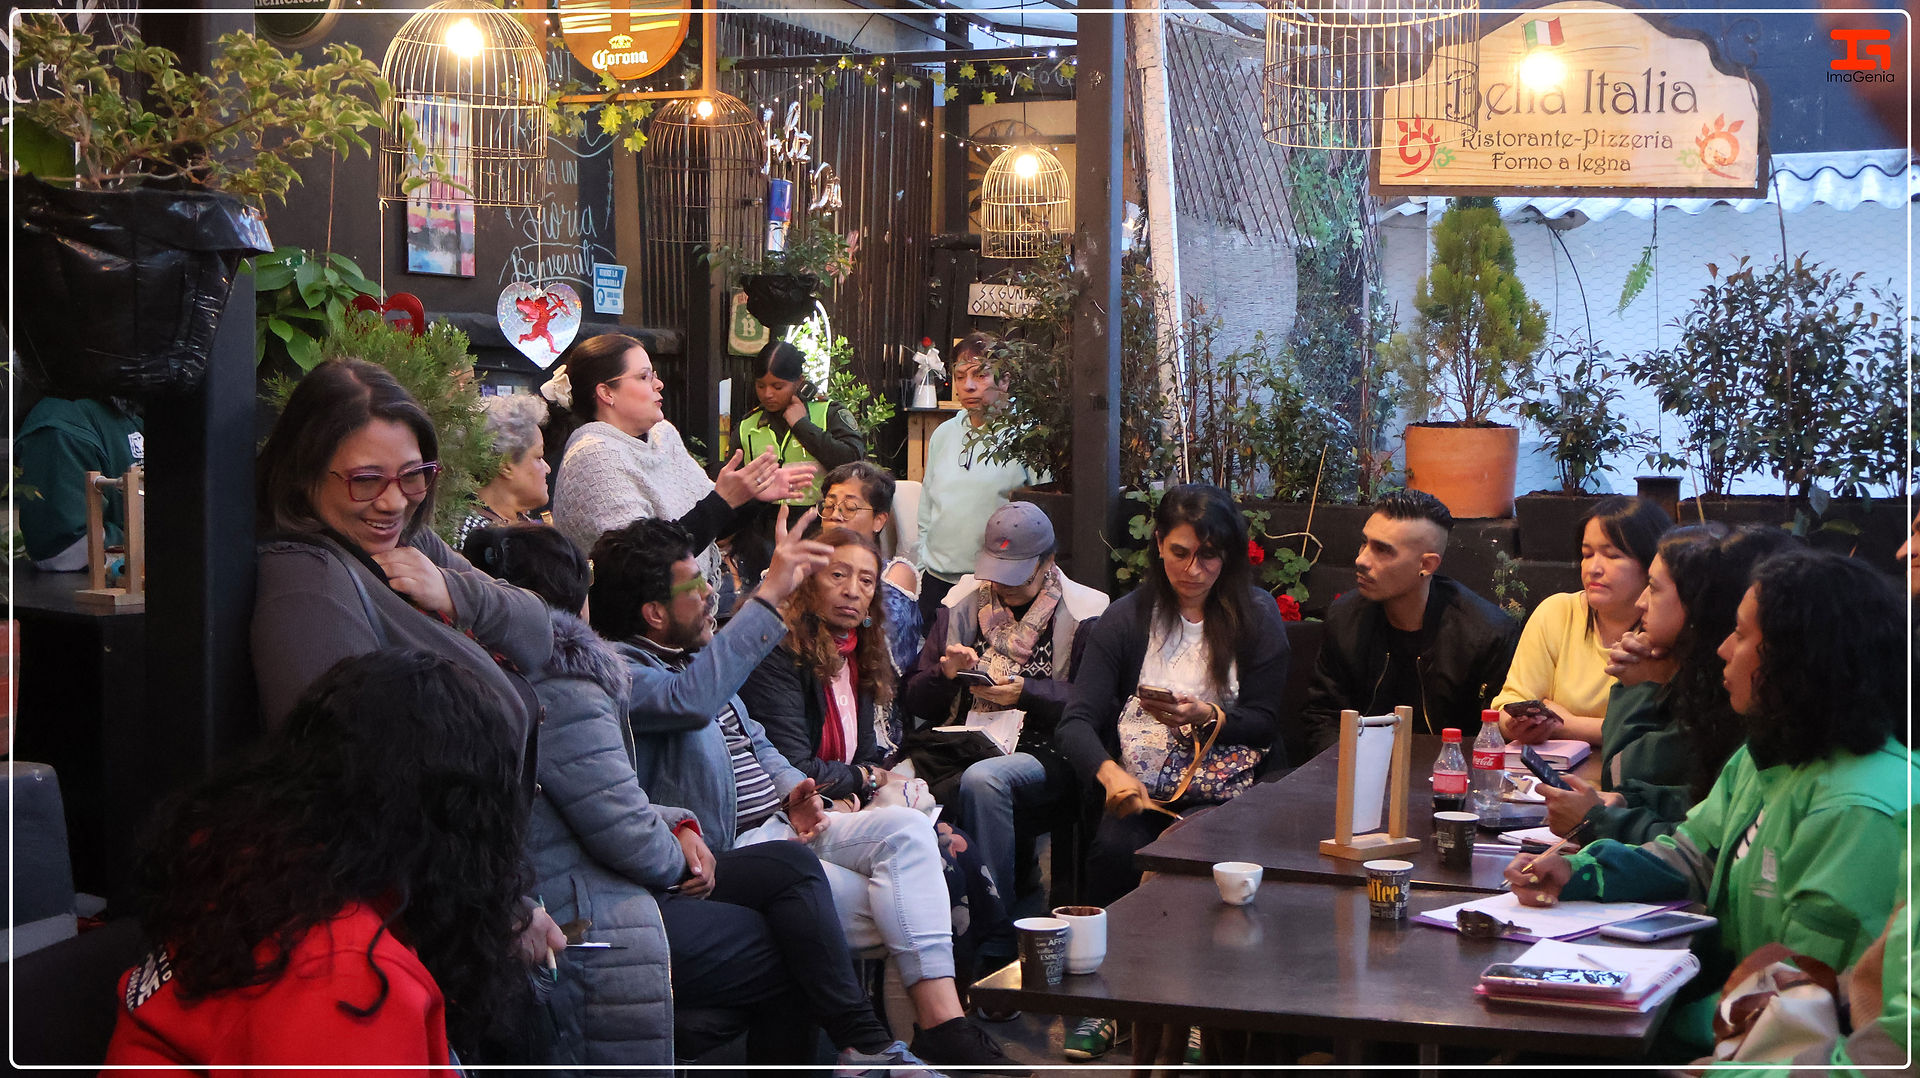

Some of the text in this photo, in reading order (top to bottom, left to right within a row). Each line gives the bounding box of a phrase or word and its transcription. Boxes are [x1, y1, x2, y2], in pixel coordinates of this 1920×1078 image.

[592, 50, 648, 70] Corona
[1582, 67, 1698, 115] Italia
[1461, 128, 1673, 150] Ristorante-Pizzeria
[1491, 152, 1631, 175] Forno a legna
